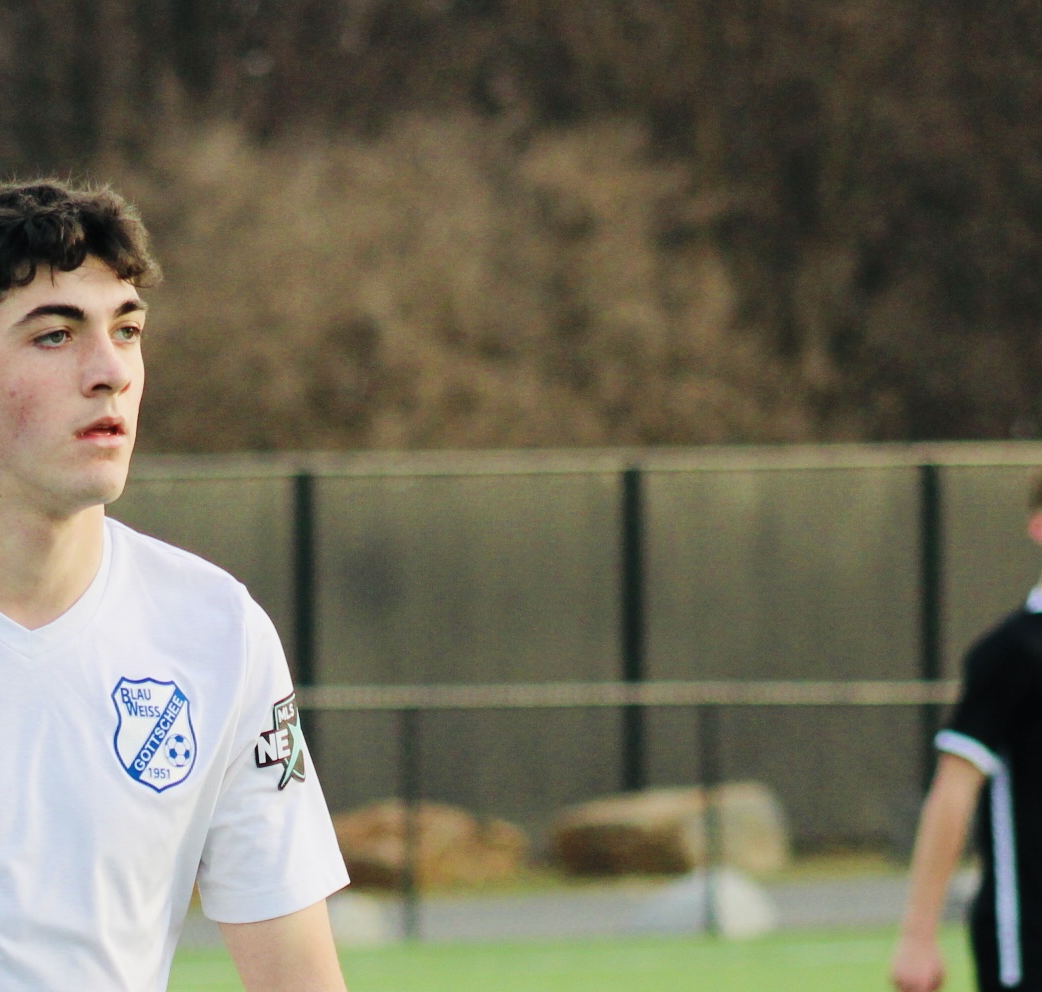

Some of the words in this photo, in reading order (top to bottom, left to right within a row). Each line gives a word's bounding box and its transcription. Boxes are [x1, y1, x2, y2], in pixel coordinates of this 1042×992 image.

[120, 687, 151, 704] BLAU
[126, 701, 161, 718] WEISS
[277, 703, 295, 723] MLS
[133, 694, 184, 772] GOTTSCHEE
[148, 767, 171, 779] 1951
